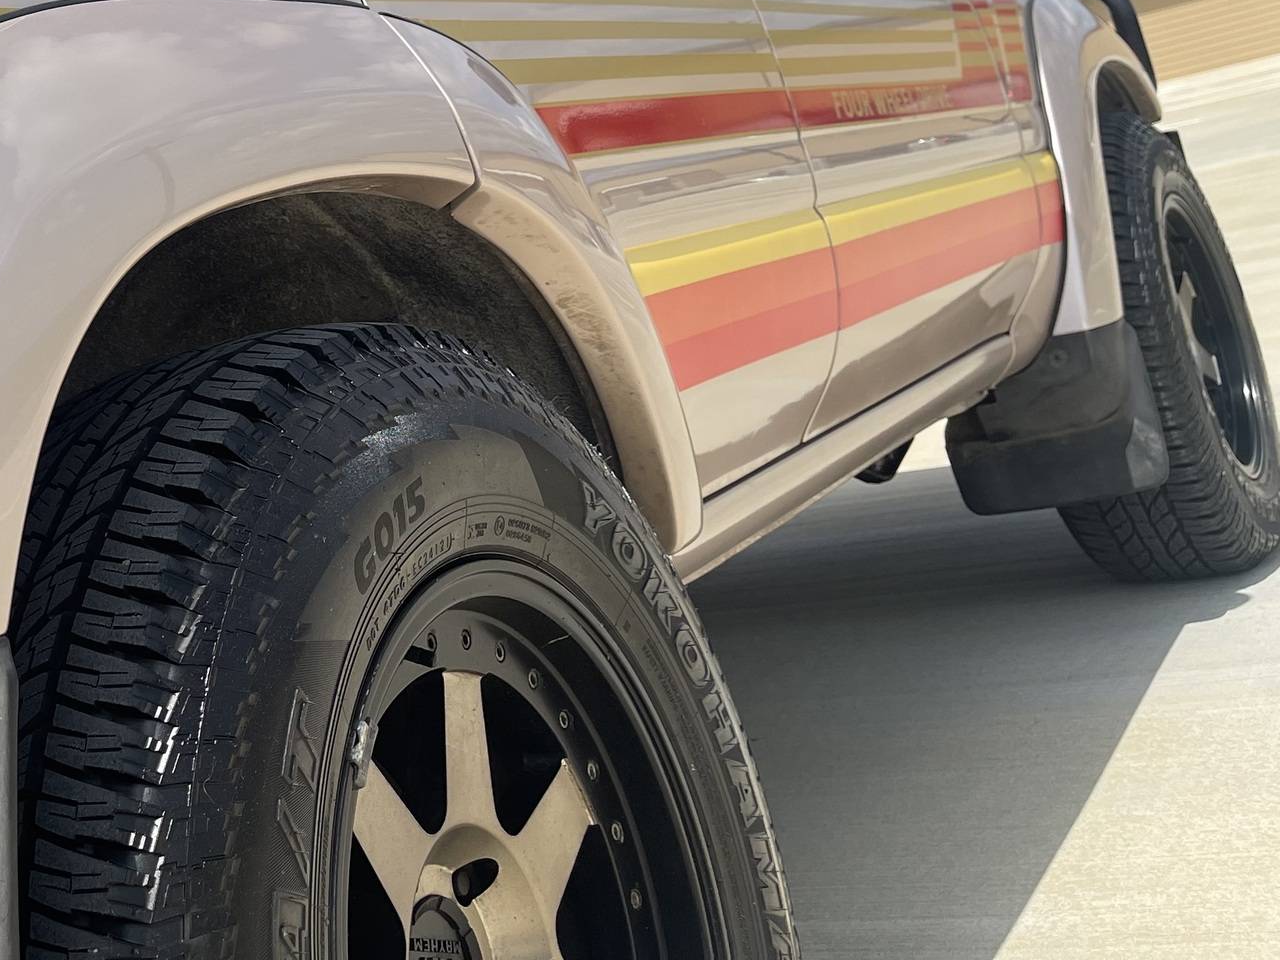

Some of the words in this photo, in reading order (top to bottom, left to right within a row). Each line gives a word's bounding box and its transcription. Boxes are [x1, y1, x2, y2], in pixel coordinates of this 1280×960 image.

[831, 89, 875, 119] FOUR
[868, 86, 920, 116] WHEEL
[578, 478, 796, 960] YOKOHAMA
[414, 938, 461, 954] MAYHEM
